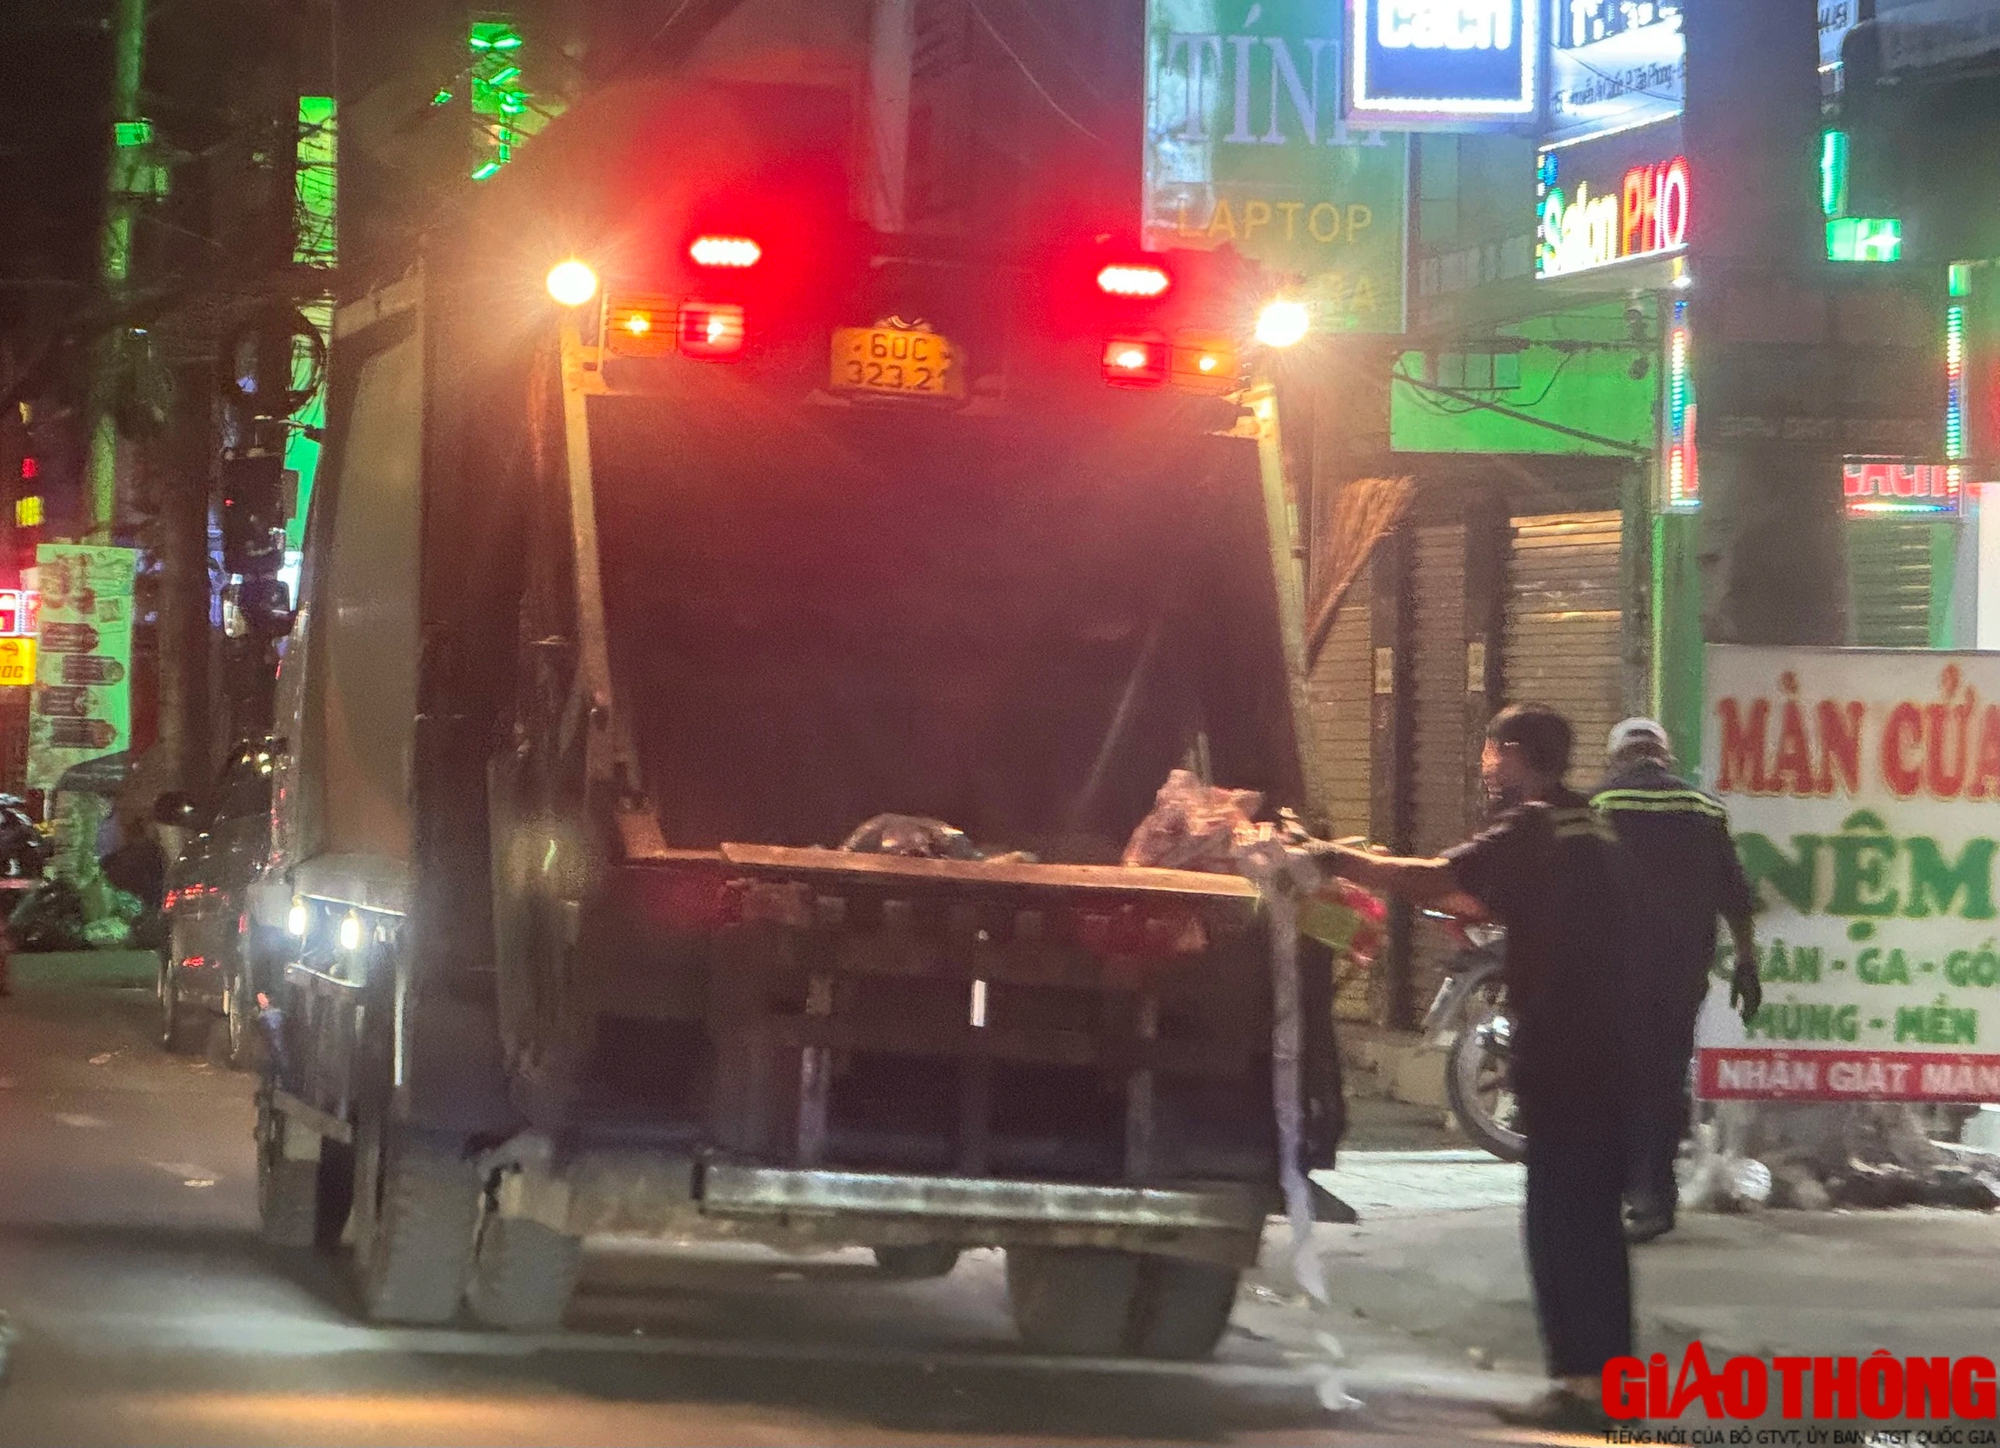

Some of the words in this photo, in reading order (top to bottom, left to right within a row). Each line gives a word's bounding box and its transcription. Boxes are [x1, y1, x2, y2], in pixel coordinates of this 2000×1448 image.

[1176, 199, 1373, 244] LAPTOP
[871, 333, 928, 361] 60C
[1734, 809, 1998, 941] NỆM
